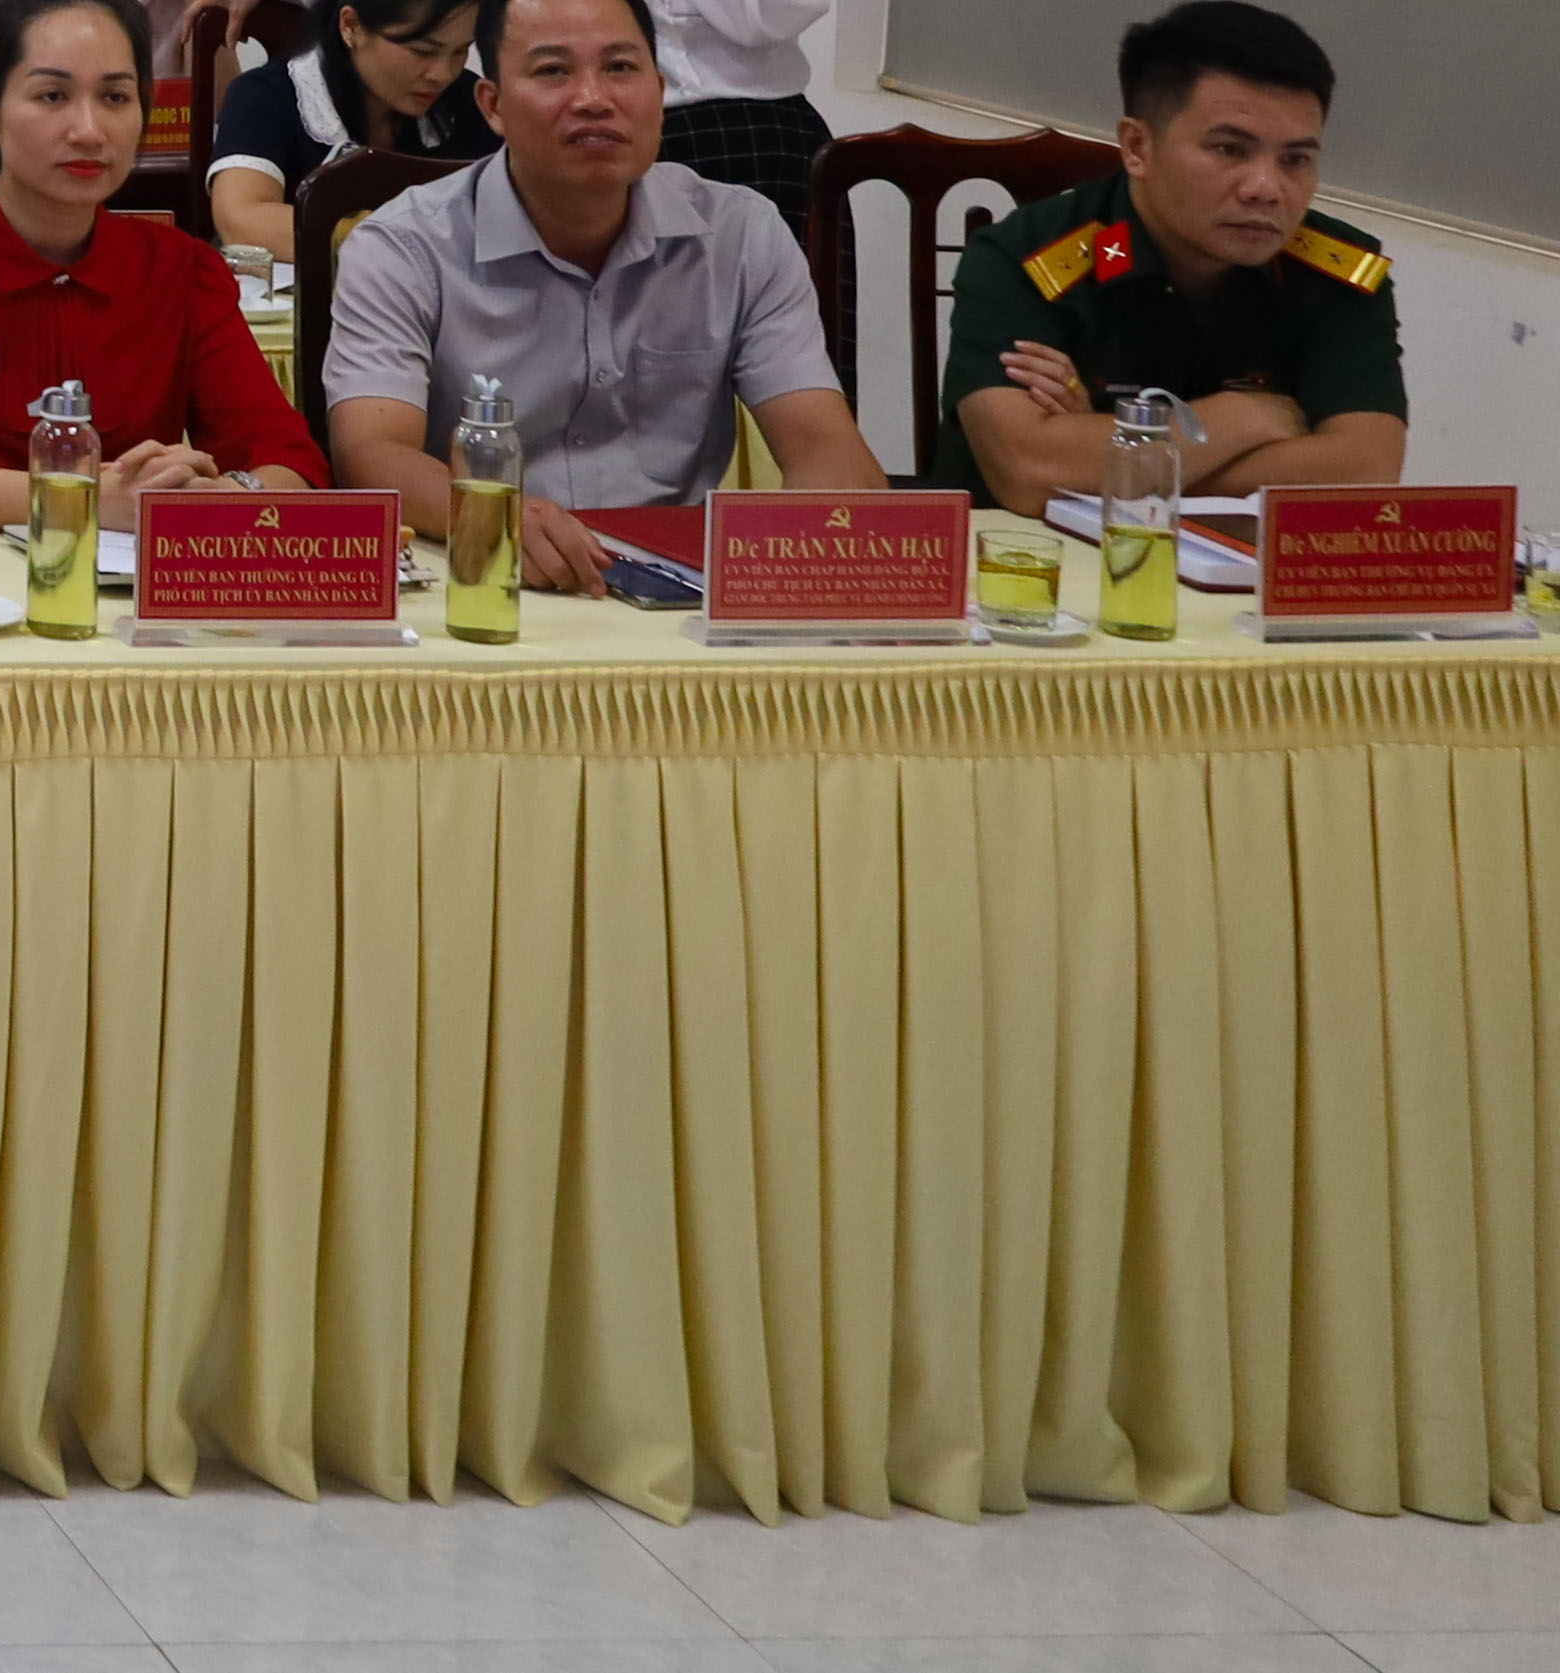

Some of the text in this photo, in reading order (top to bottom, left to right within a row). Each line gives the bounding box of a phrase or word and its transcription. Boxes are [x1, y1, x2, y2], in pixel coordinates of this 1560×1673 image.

[156, 536, 183, 559] Đ/c
[272, 536, 327, 565] NGỌC
[332, 537, 380, 559] LINH
